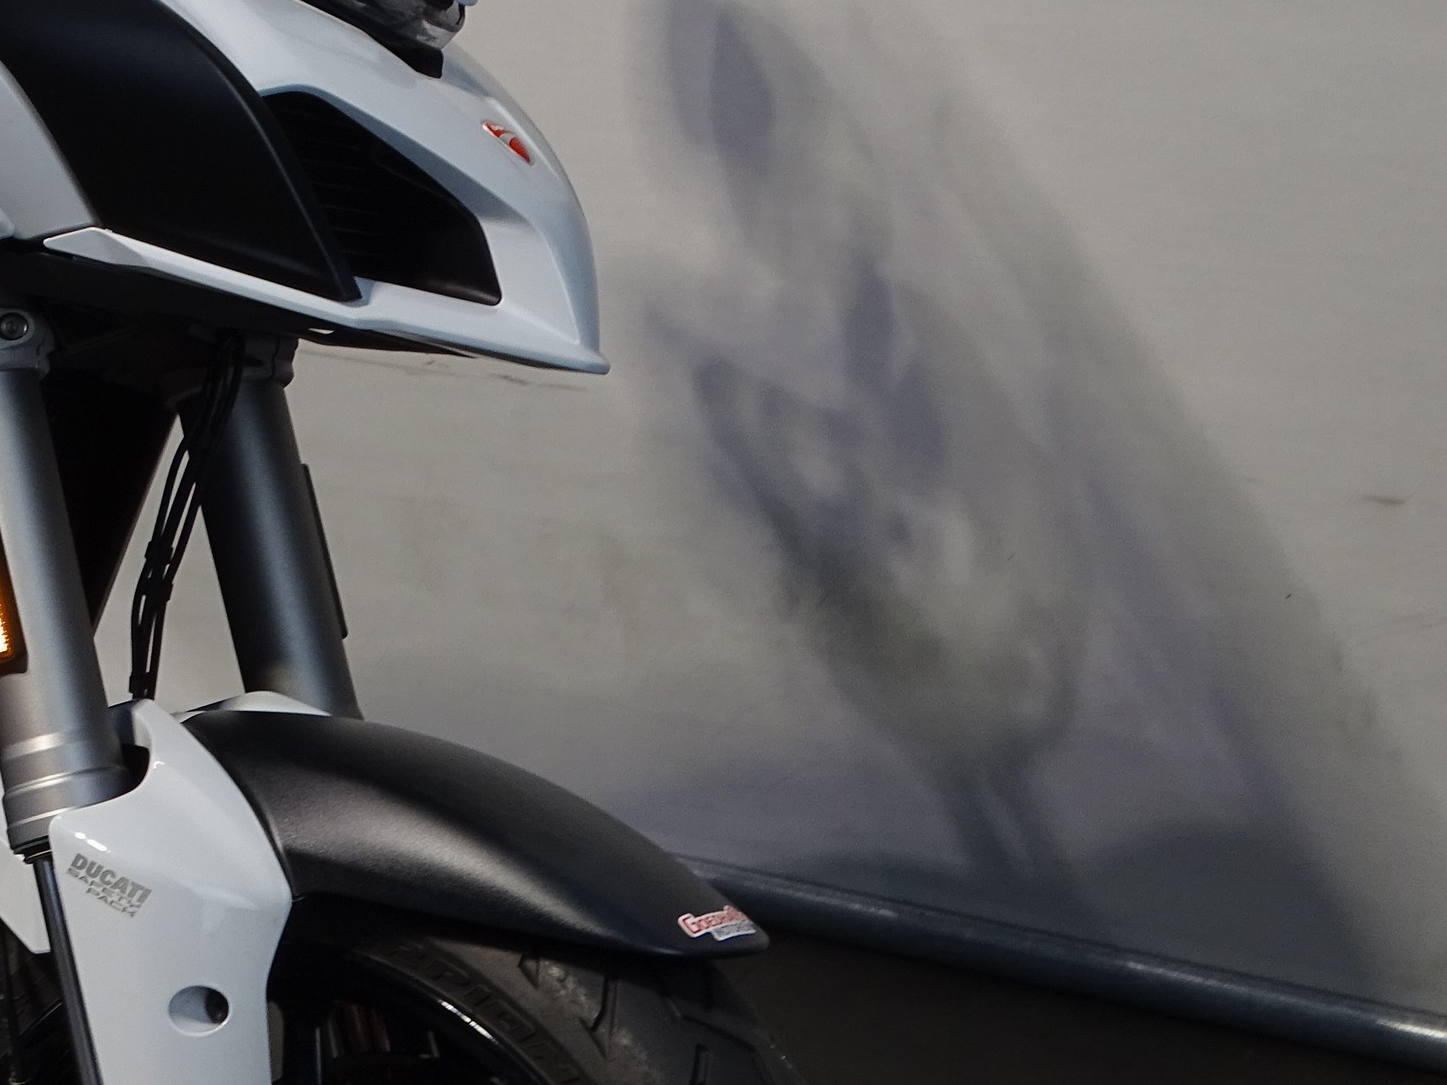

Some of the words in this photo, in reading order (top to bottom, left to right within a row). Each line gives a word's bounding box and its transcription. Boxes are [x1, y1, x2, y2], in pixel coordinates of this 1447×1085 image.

[67, 868, 140, 908] SAFETY
[71, 853, 152, 903] DUCATI
[86, 888, 136, 917] PACK
